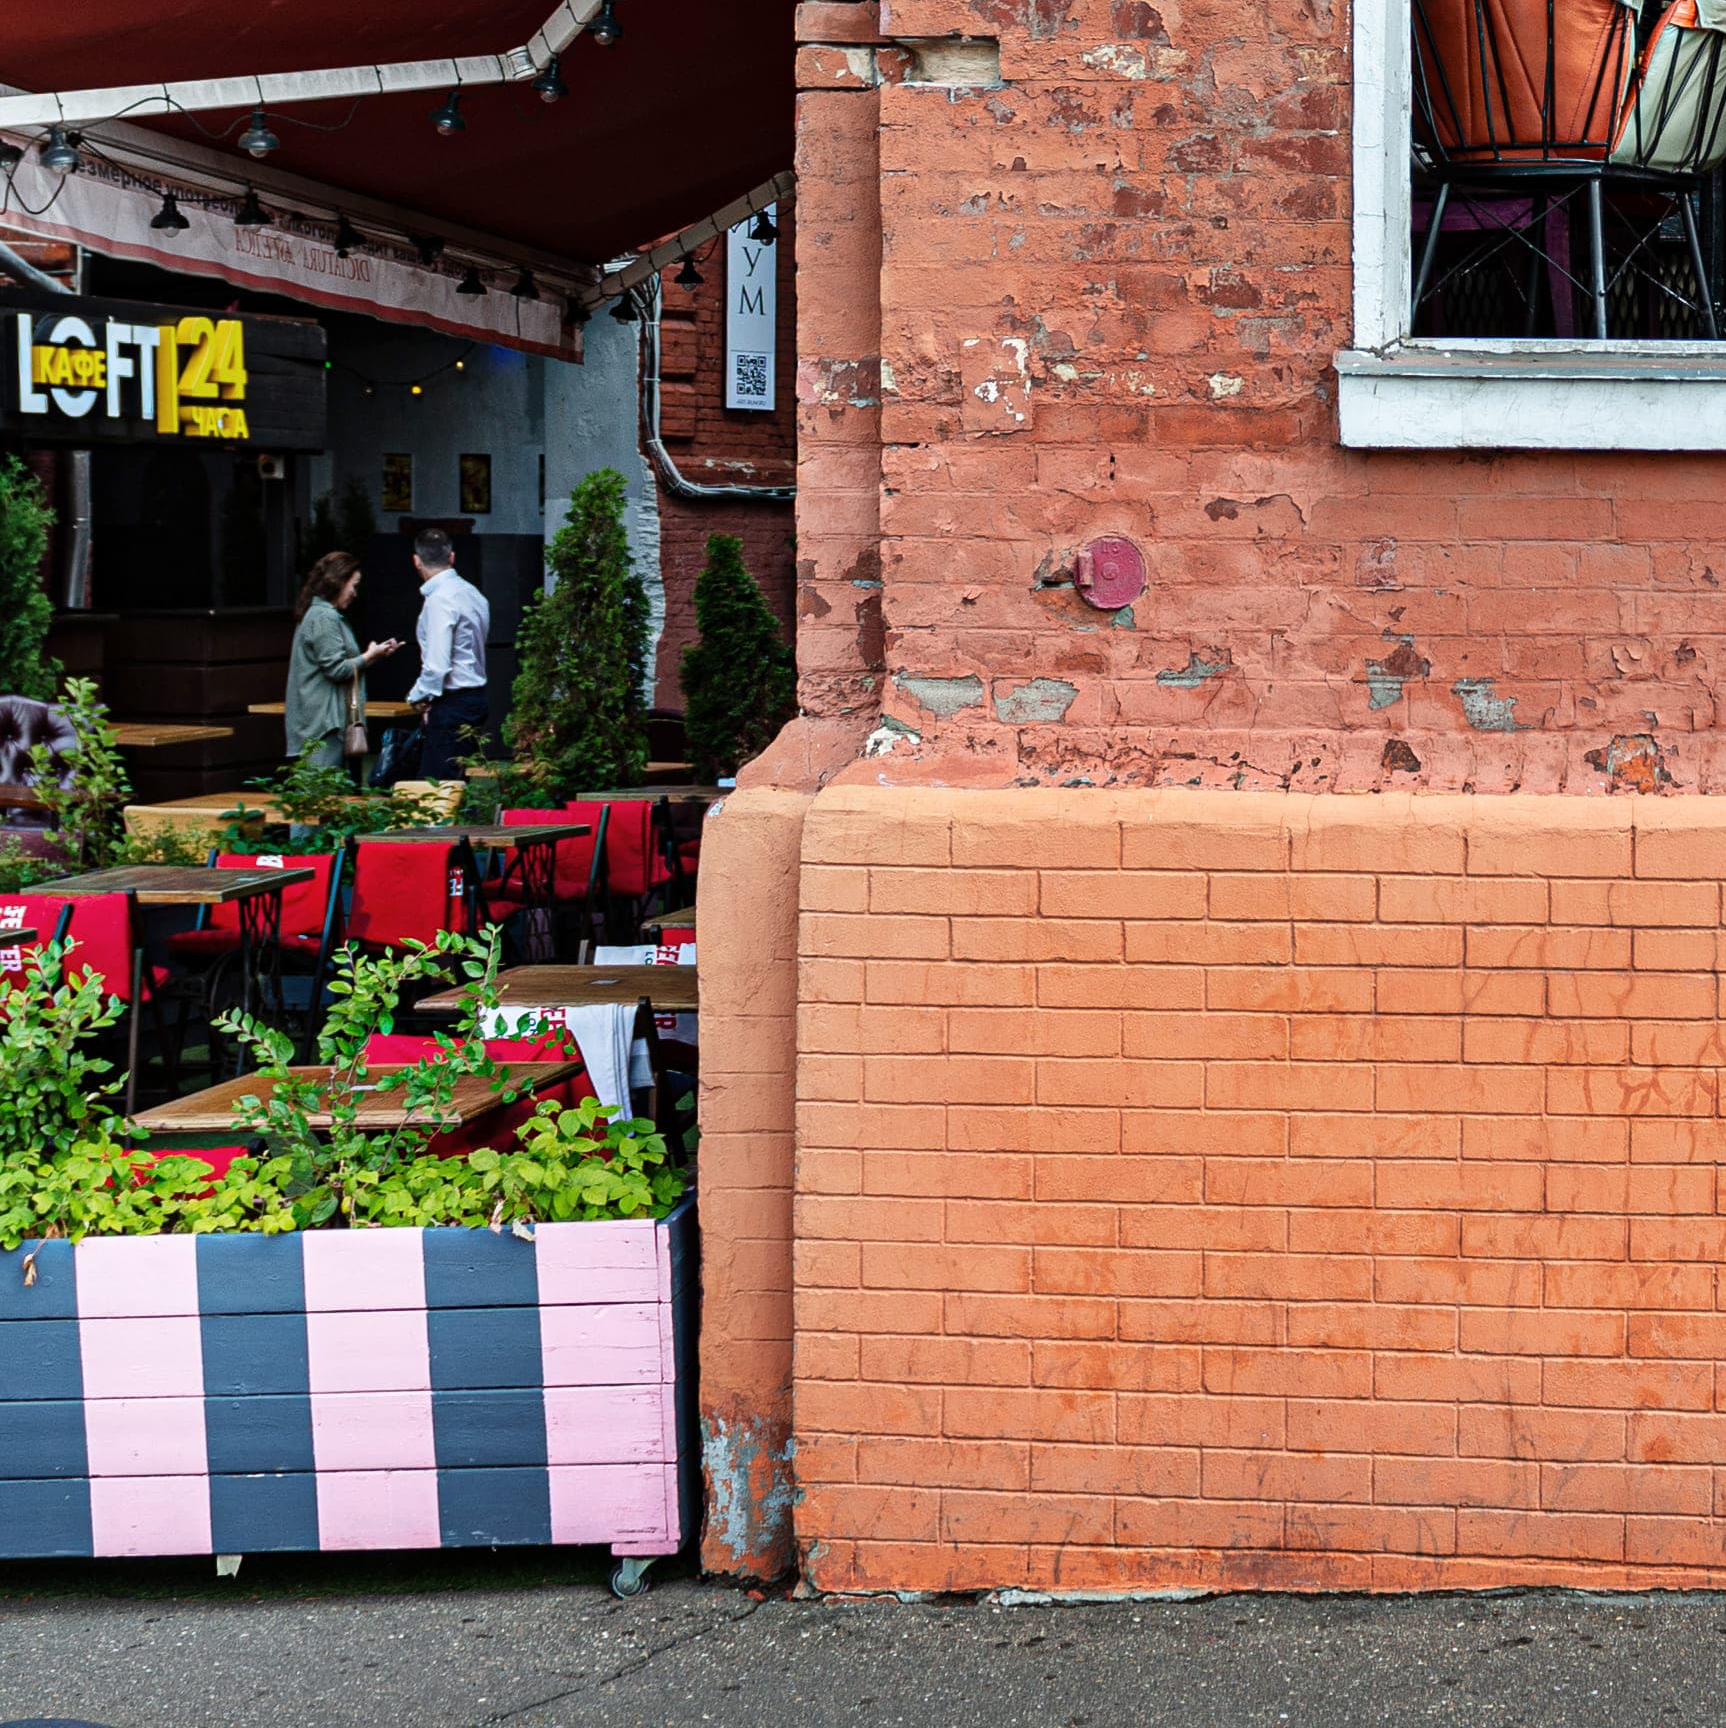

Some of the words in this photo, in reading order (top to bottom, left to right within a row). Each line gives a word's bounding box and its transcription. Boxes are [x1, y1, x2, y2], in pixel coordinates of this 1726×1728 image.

[17, 313, 161, 420] LOFT
[38, 346, 107, 388] КАФЕ
[177, 316, 248, 400] 24
[187, 405, 250, 439] ЧАСА
